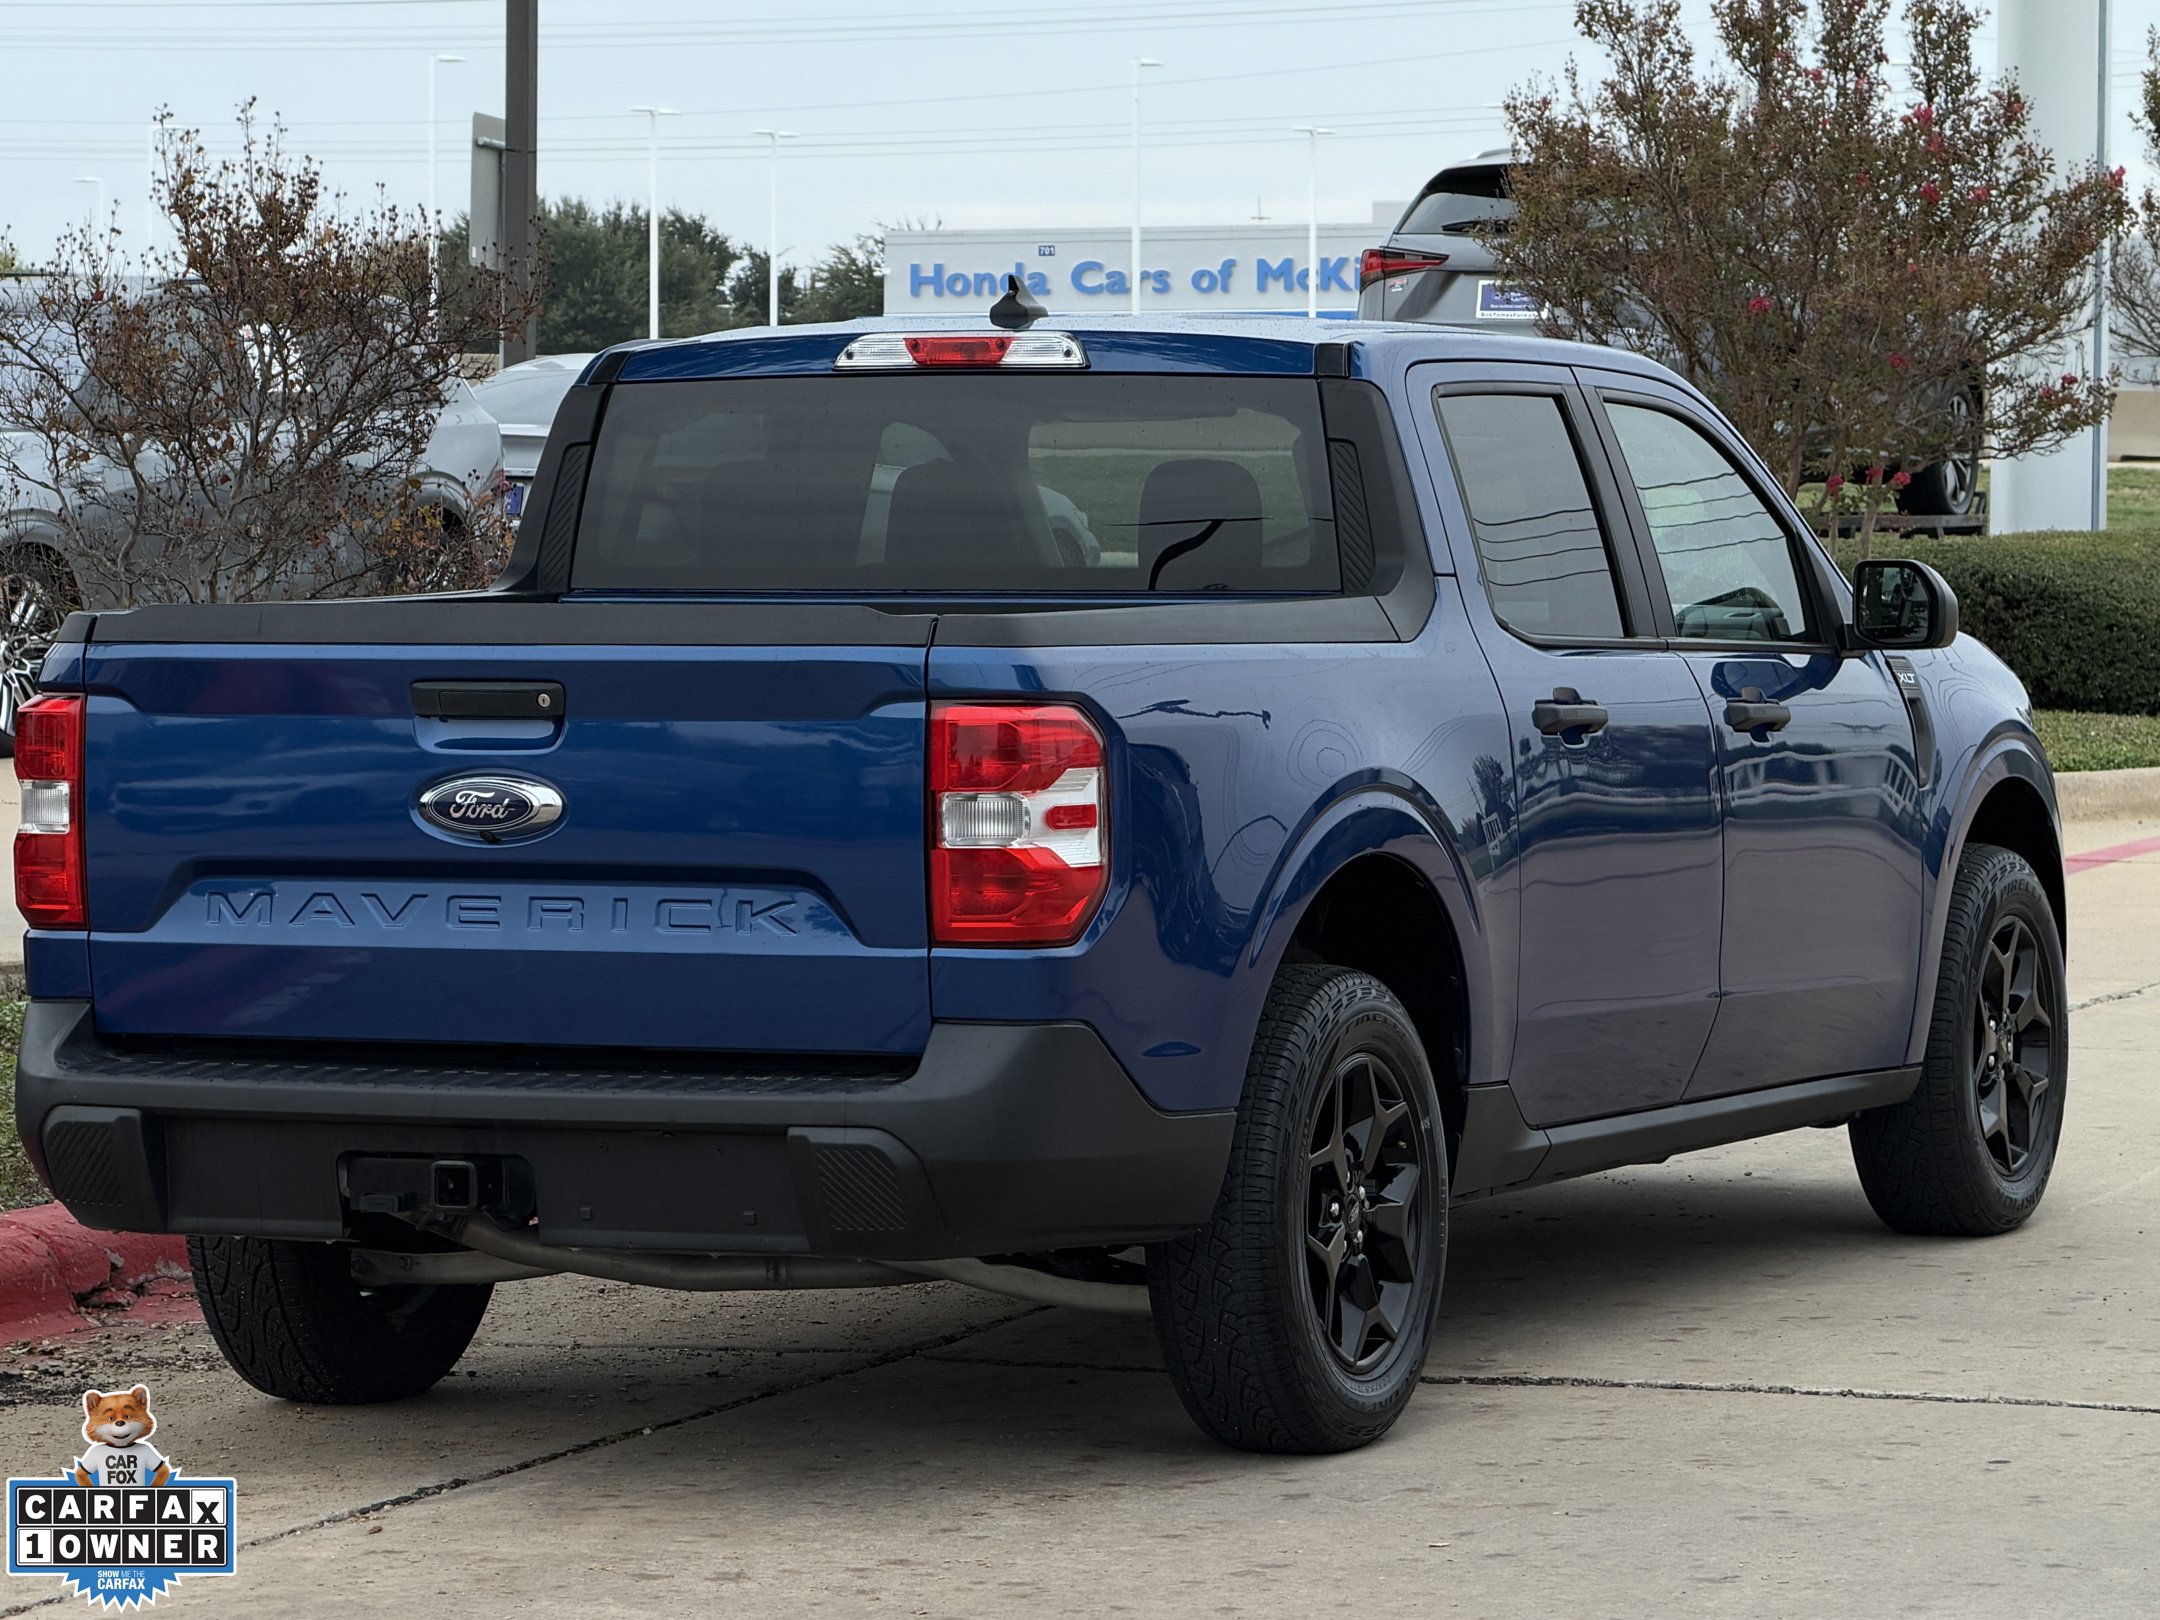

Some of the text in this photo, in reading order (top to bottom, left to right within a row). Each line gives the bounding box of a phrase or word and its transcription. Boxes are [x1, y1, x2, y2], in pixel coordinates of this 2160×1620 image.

[1039, 246, 1056, 256] 701
[910, 262, 1052, 297] Honda
[1191, 258, 1237, 293] of
[1897, 673, 1915, 684] XLT
[449, 790, 515, 819] Ford
[205, 890, 799, 937] MAVERICK
